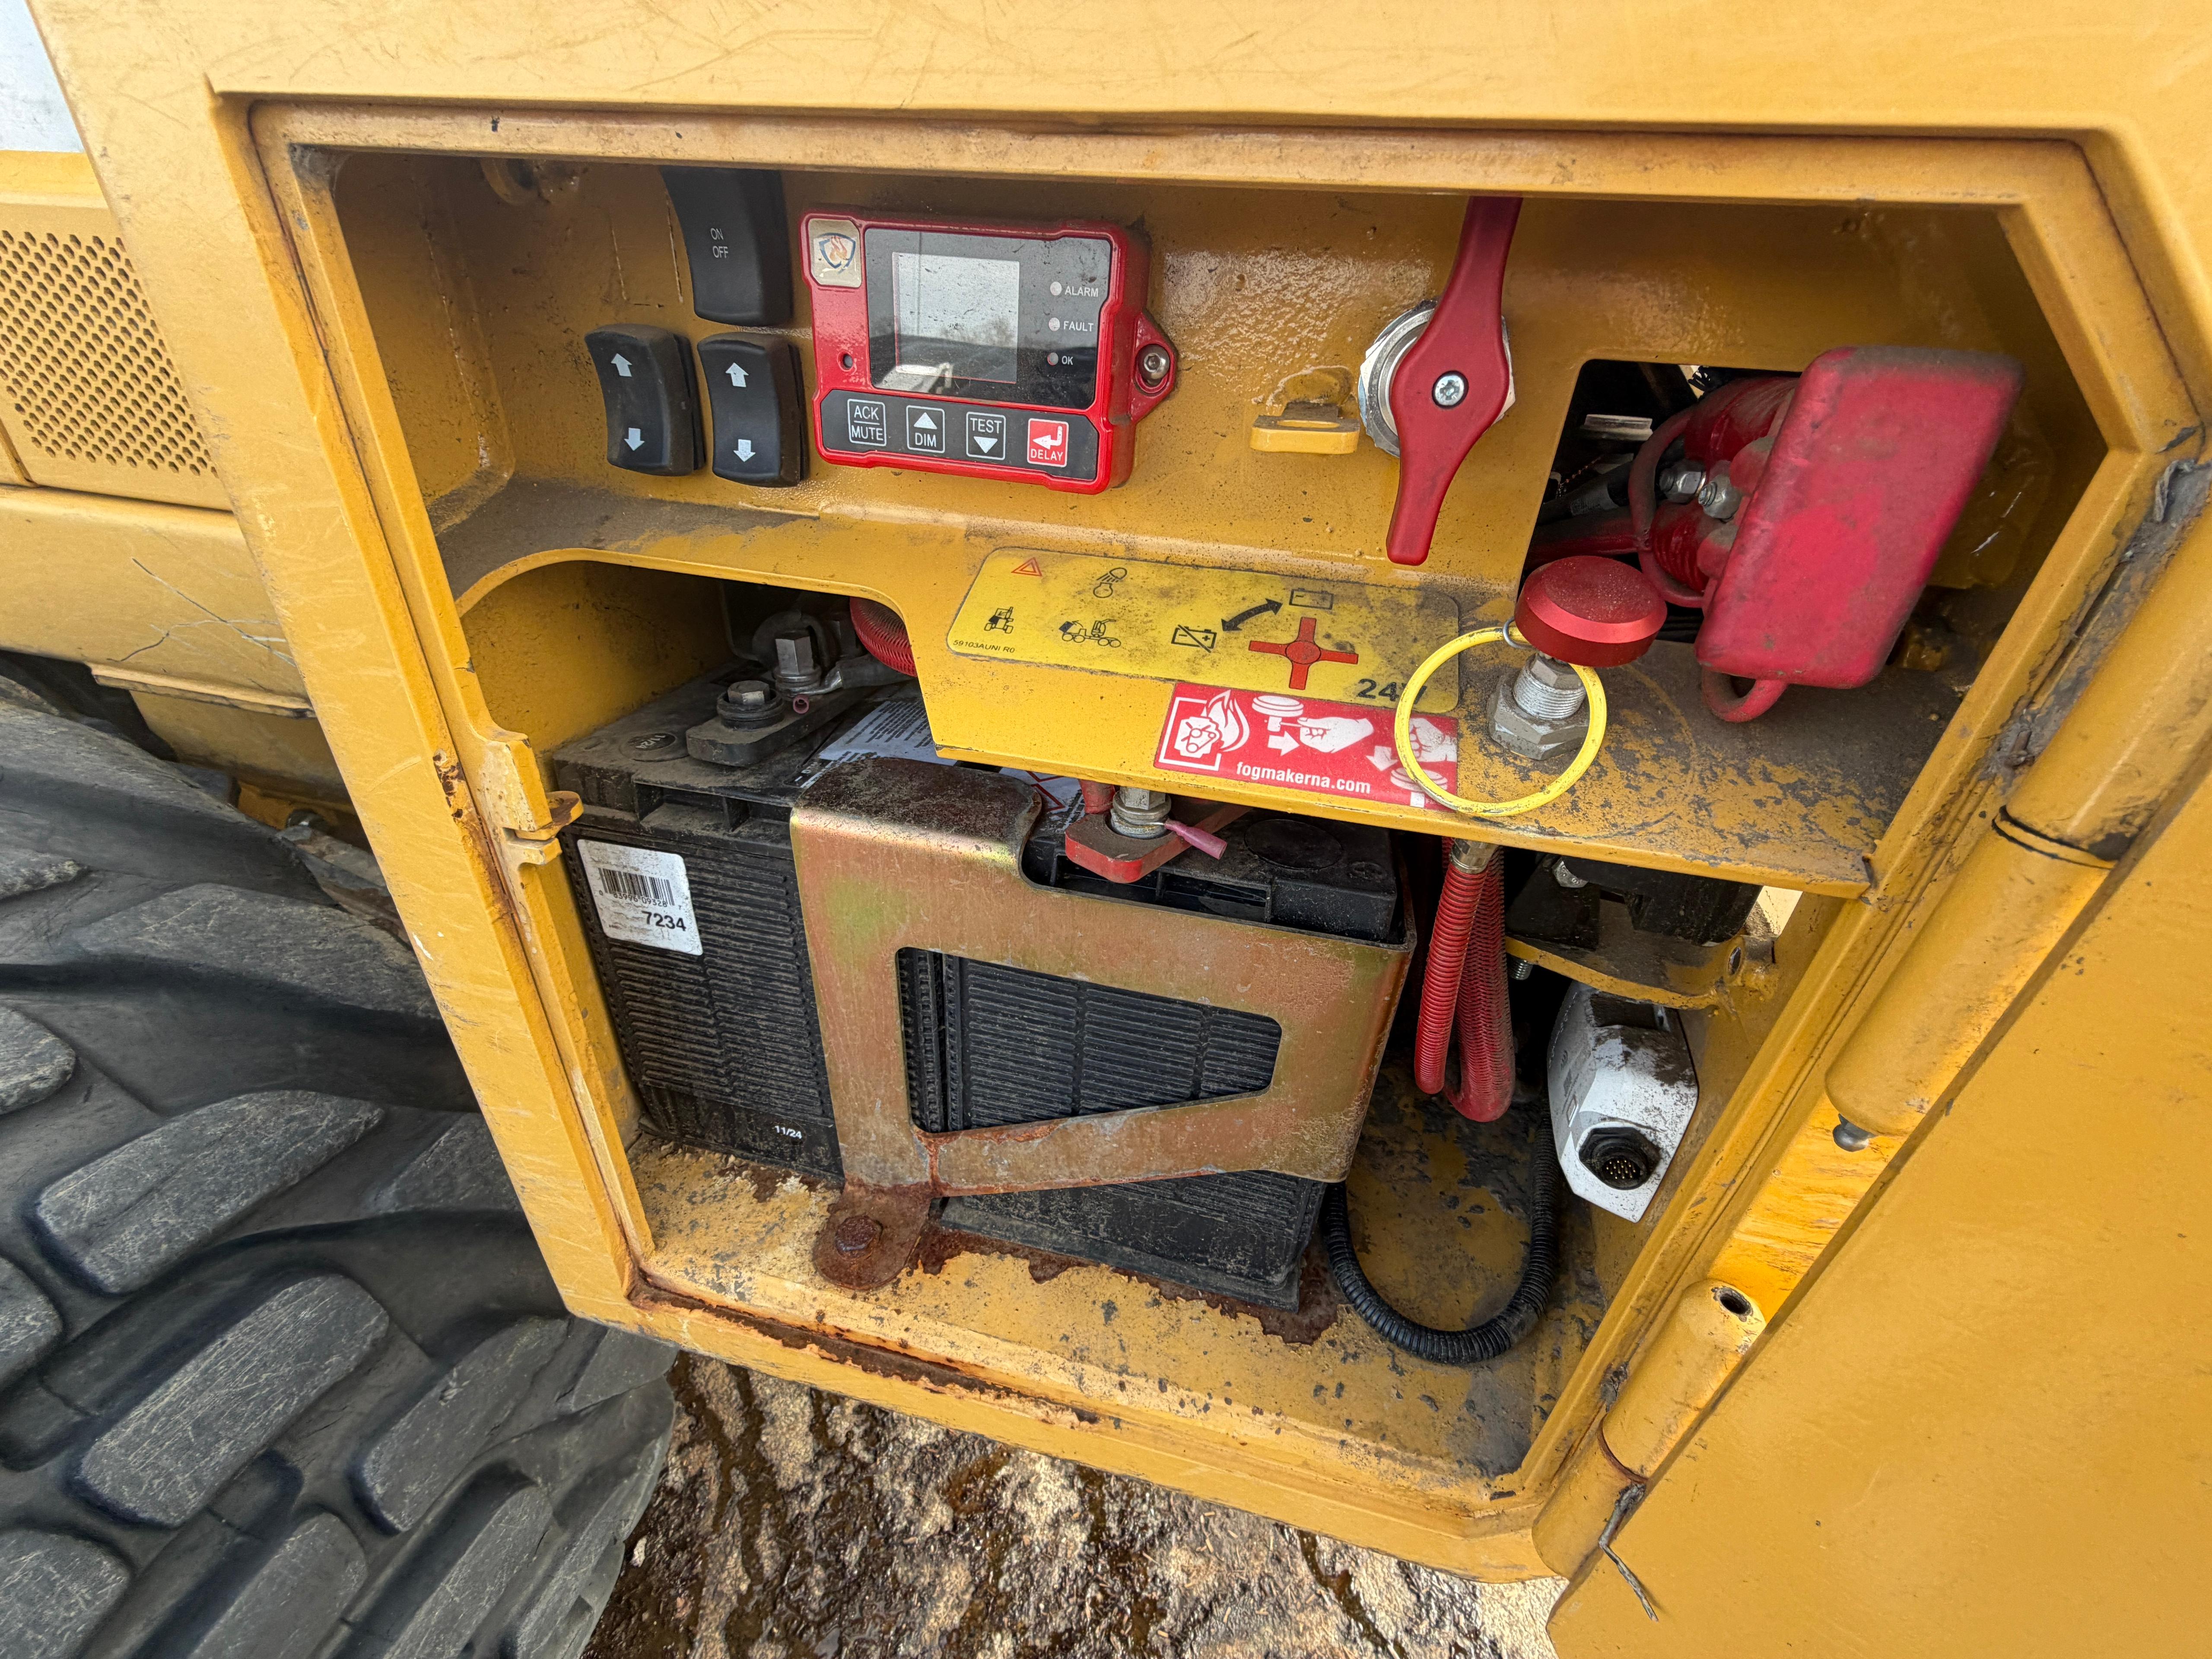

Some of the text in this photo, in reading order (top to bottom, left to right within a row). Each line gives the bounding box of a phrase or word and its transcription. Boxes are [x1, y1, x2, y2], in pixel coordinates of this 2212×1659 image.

[710, 228, 724, 240] ON
[712, 245, 729, 258] OFF
[1065, 286, 1099, 297] ALARM
[1063, 321, 1094, 332] FAULT
[1062, 355, 1074, 365] OK
[854, 405, 879, 420] ACK
[970, 417, 1002, 434] TEST
[851, 425, 884, 441] MUTE
[915, 432, 937, 448] DIM
[1030, 448, 1064, 461] DELAY
[953, 639, 1001, 651] 59103AUNI
[1236, 762, 1371, 794] fogmakerna.com
[642, 910, 686, 932] 7234
[775, 1125, 802, 1139] 11/24
